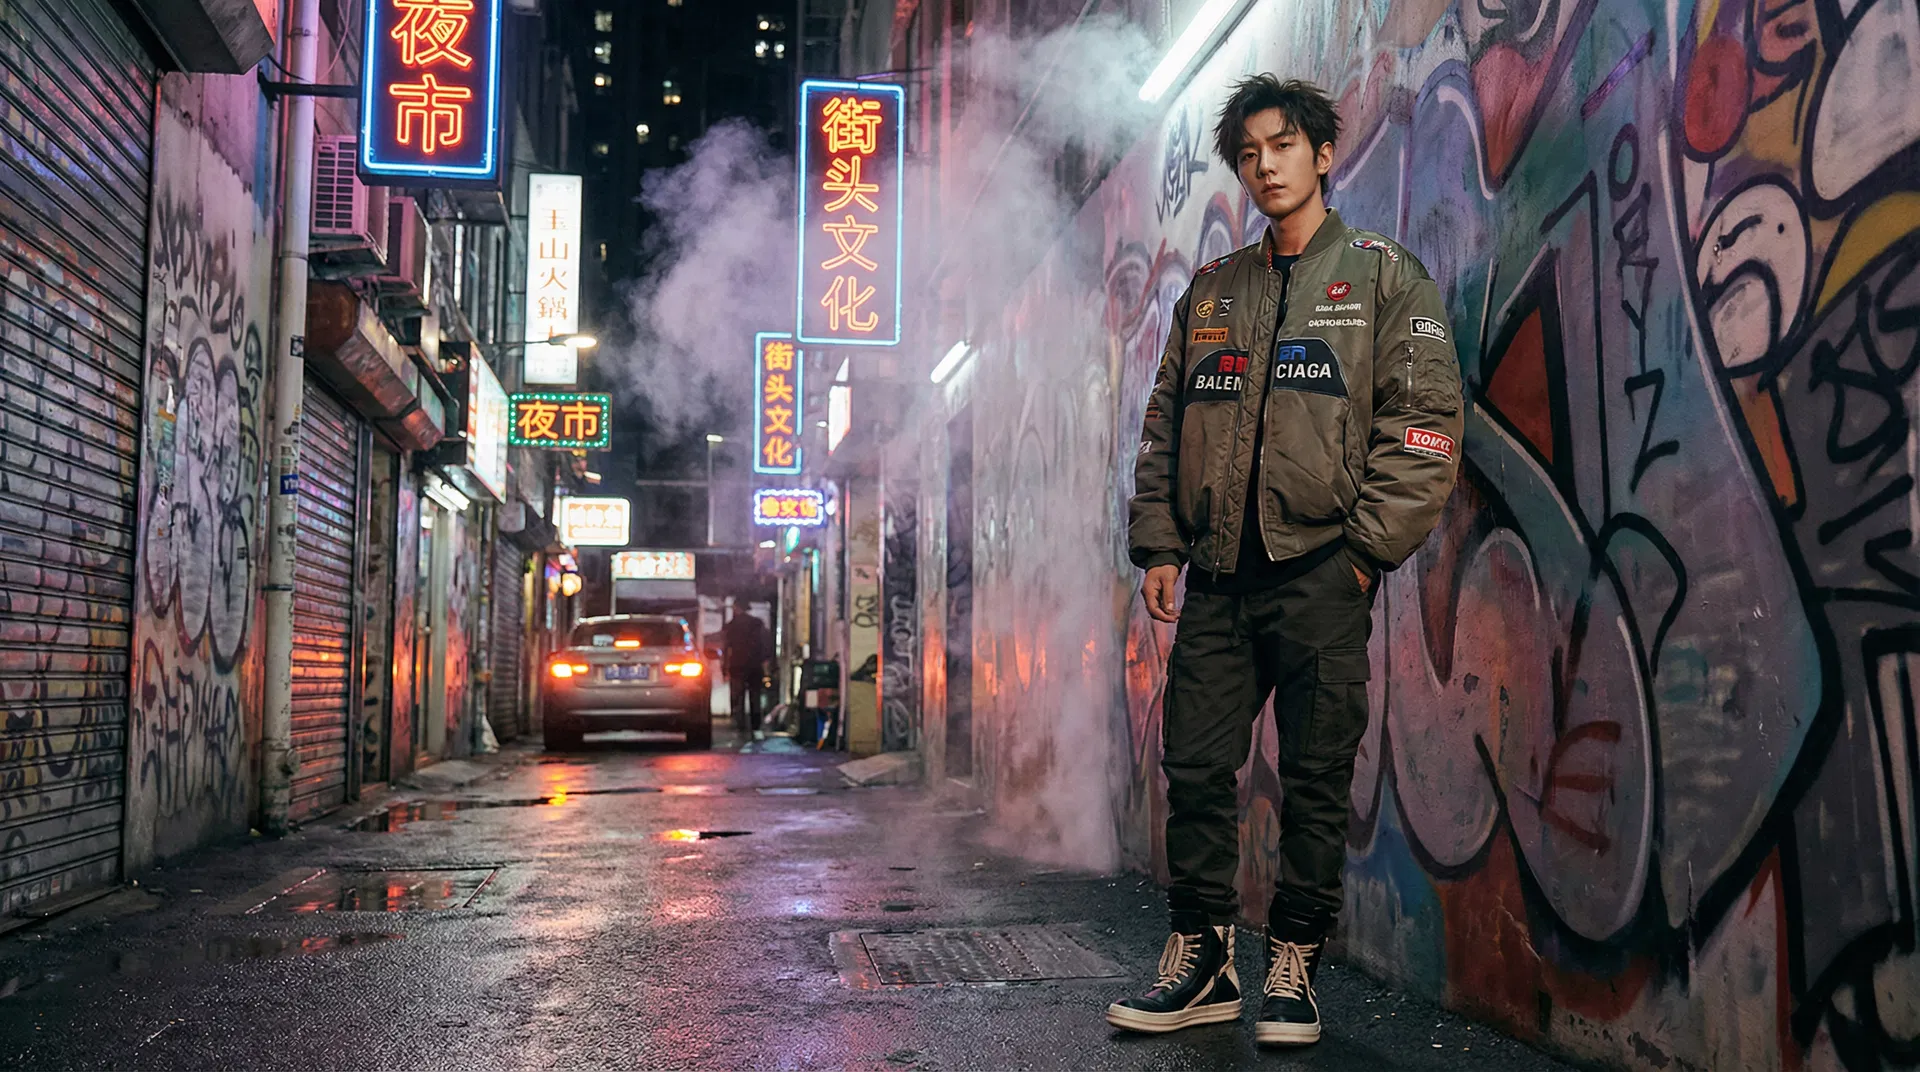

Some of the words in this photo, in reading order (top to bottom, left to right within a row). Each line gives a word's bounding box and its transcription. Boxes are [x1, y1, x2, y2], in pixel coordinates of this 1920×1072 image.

[389, 0, 475, 155] 夜市
[822, 96, 882, 332] 街头文化
[517, 401, 602, 440] 夜市
[764, 341, 793, 466] 街头文化
[1195, 374, 1243, 391] BALEN
[1276, 363, 1332, 379] CIAGA
